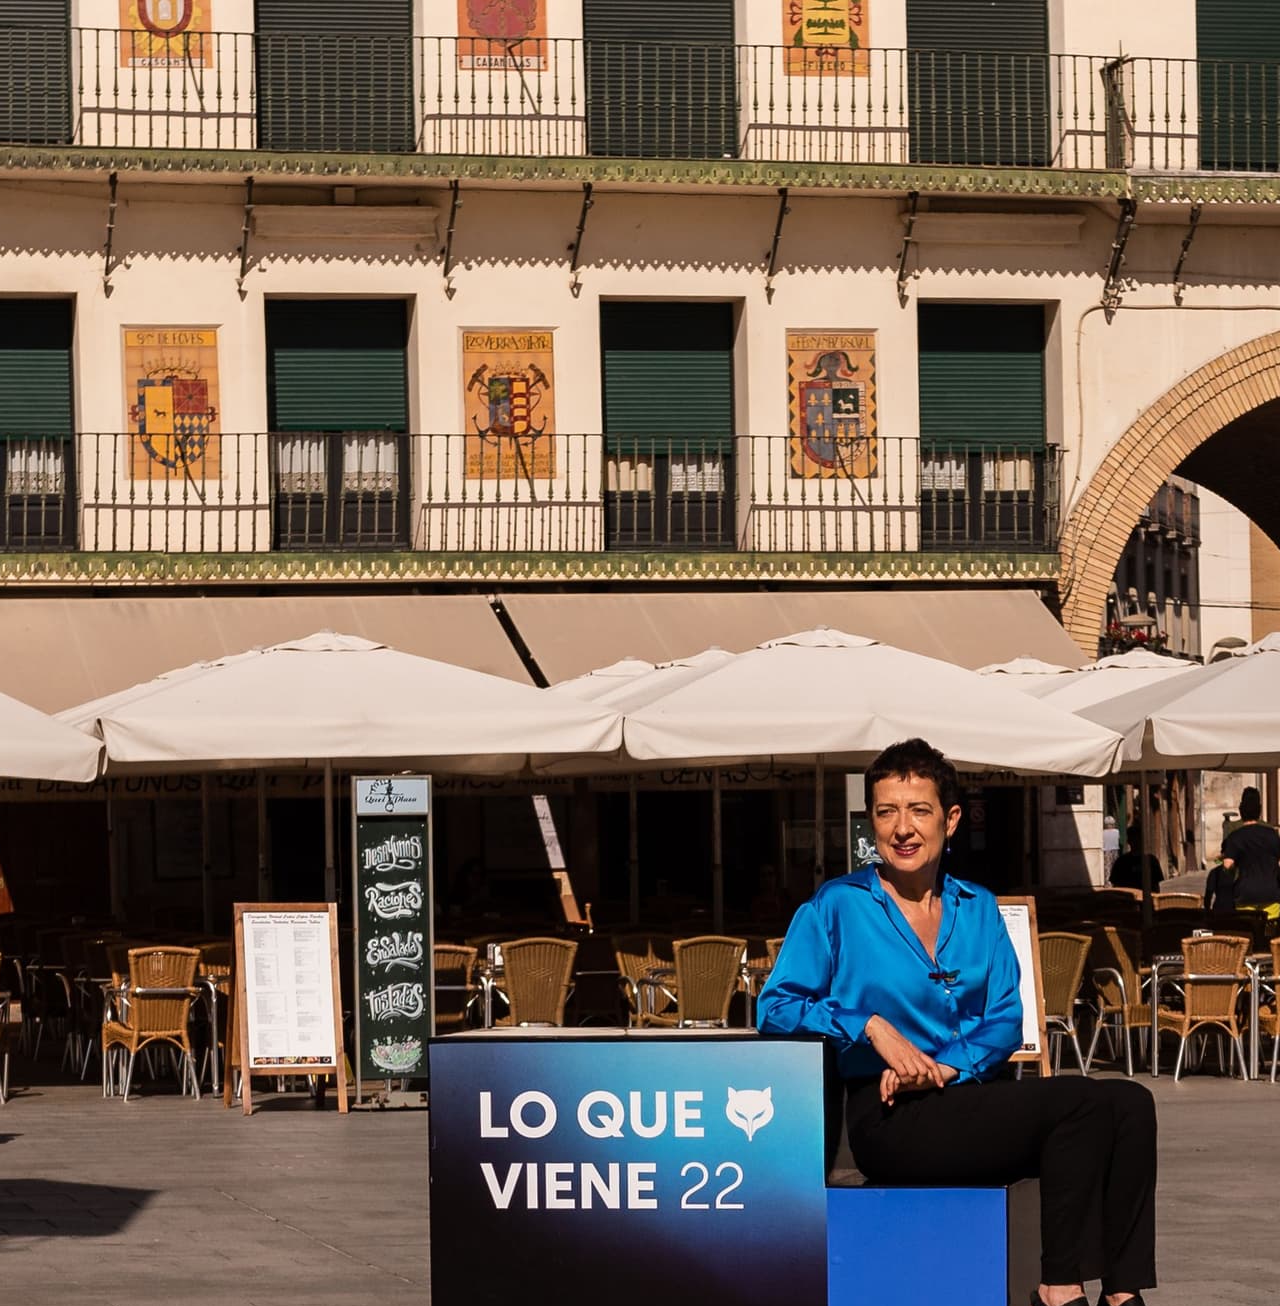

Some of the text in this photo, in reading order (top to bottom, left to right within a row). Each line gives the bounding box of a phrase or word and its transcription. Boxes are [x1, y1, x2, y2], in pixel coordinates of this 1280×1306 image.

[479, 1090, 704, 1138] LO QUE
[480, 1161, 745, 1210] VIENE 22
